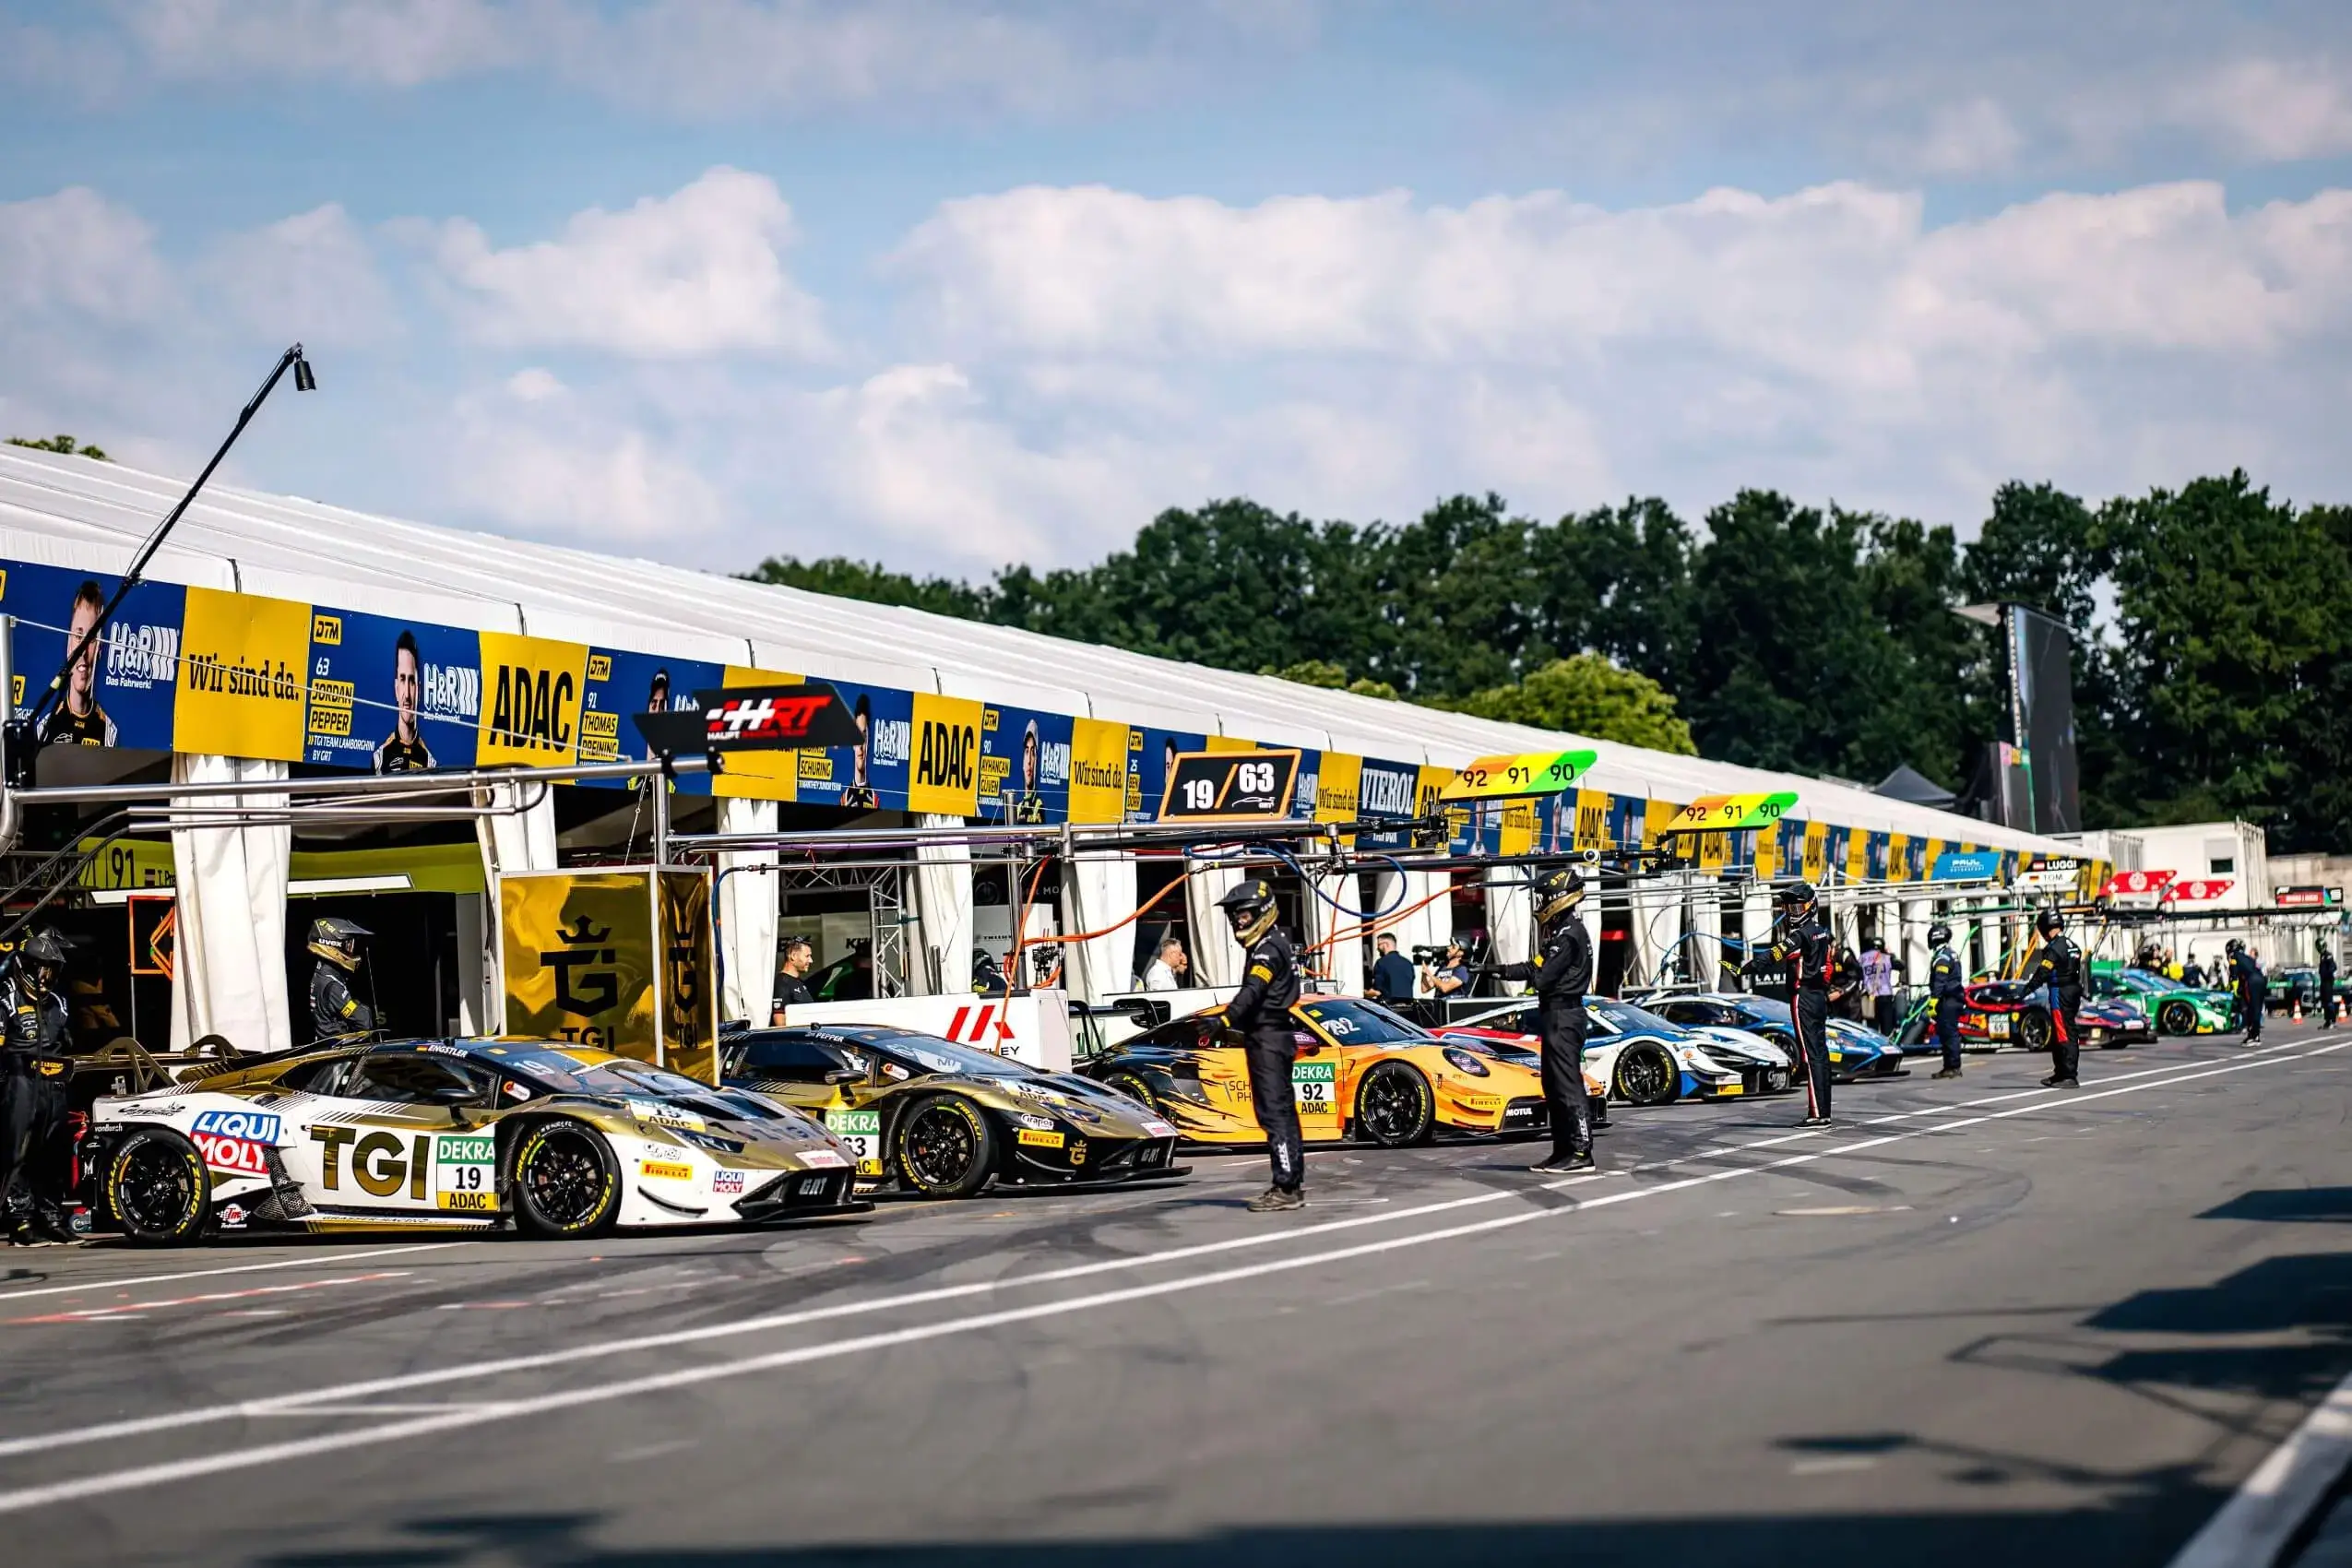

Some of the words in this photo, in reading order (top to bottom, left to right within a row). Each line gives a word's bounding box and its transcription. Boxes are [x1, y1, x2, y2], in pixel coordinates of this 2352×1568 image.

[315, 620, 339, 639] DTM
[107, 622, 152, 679] H&R
[315, 657, 330, 676] 63
[590, 659, 609, 676] DTM
[106, 675, 119, 687] Das
[120, 677, 151, 690] Fahrwerk!
[189, 653, 222, 694] Wir
[230, 655, 269, 697] sind
[273, 660, 299, 701] da.
[312, 683, 352, 705] JORDAN
[423, 662, 460, 714] H&R
[489, 664, 573, 753] ADAC
[588, 692, 597, 709] 91
[311, 710, 350, 731] PEPPER
[722, 695, 833, 731] HRT
[584, 714, 617, 732] THOMAS
[323, 736, 339, 748] TEAM
[339, 738, 375, 752] LAMBORGHINI
[581, 741, 617, 759] PREINING
[983, 740, 992, 754] 90
[312, 750, 321, 761] BY
[917, 720, 974, 790] ADAC
[800, 760, 831, 778] SCHURING
[1074, 760, 1091, 786] Wir
[1091, 760, 1111, 788] sind
[1239, 763, 1275, 793] 63
[1463, 769, 1487, 788] 92
[1508, 766, 1529, 784] 91
[1550, 764, 1574, 781] 90
[1182, 779, 1215, 810] 19
[1318, 787, 1332, 809] Wir
[1333, 787, 1348, 811] sind
[1362, 767, 1415, 815] VIEROL
[1687, 807, 1706, 822] 92
[1724, 805, 1742, 819] 91
[1760, 804, 1780, 818] 90
[1577, 806, 1602, 848] ADAC
[112, 847, 135, 887] 91
[2046, 860, 2077, 870] LUGGI
[318, 938, 342, 948] uvex
[1754, 973, 1787, 982] LAN
[560, 1026, 615, 1051] TGI
[815, 1032, 844, 1043] PEPPER
[427, 1044, 469, 1058] ENGSTLER
[1292, 1066, 1334, 1079] DEKRA
[1302, 1083, 1324, 1100] 92
[1301, 1101, 1328, 1113] ADAC
[1470, 1097, 1502, 1106] PIRELLI
[1505, 1107, 1533, 1117] MOTUL
[196, 1112, 278, 1141] LIQUI
[648, 1115, 691, 1129] ADAC
[826, 1113, 880, 1132] DEKRA
[193, 1134, 266, 1170] MOLY
[439, 1141, 495, 1160] DEKRA
[310, 1123, 431, 1201] TGI
[646, 1164, 689, 1178] PIRELLI
[456, 1167, 481, 1190] 19
[716, 1171, 744, 1182] LIQUI
[714, 1182, 742, 1193] MOLY
[449, 1194, 486, 1209] ADAC
